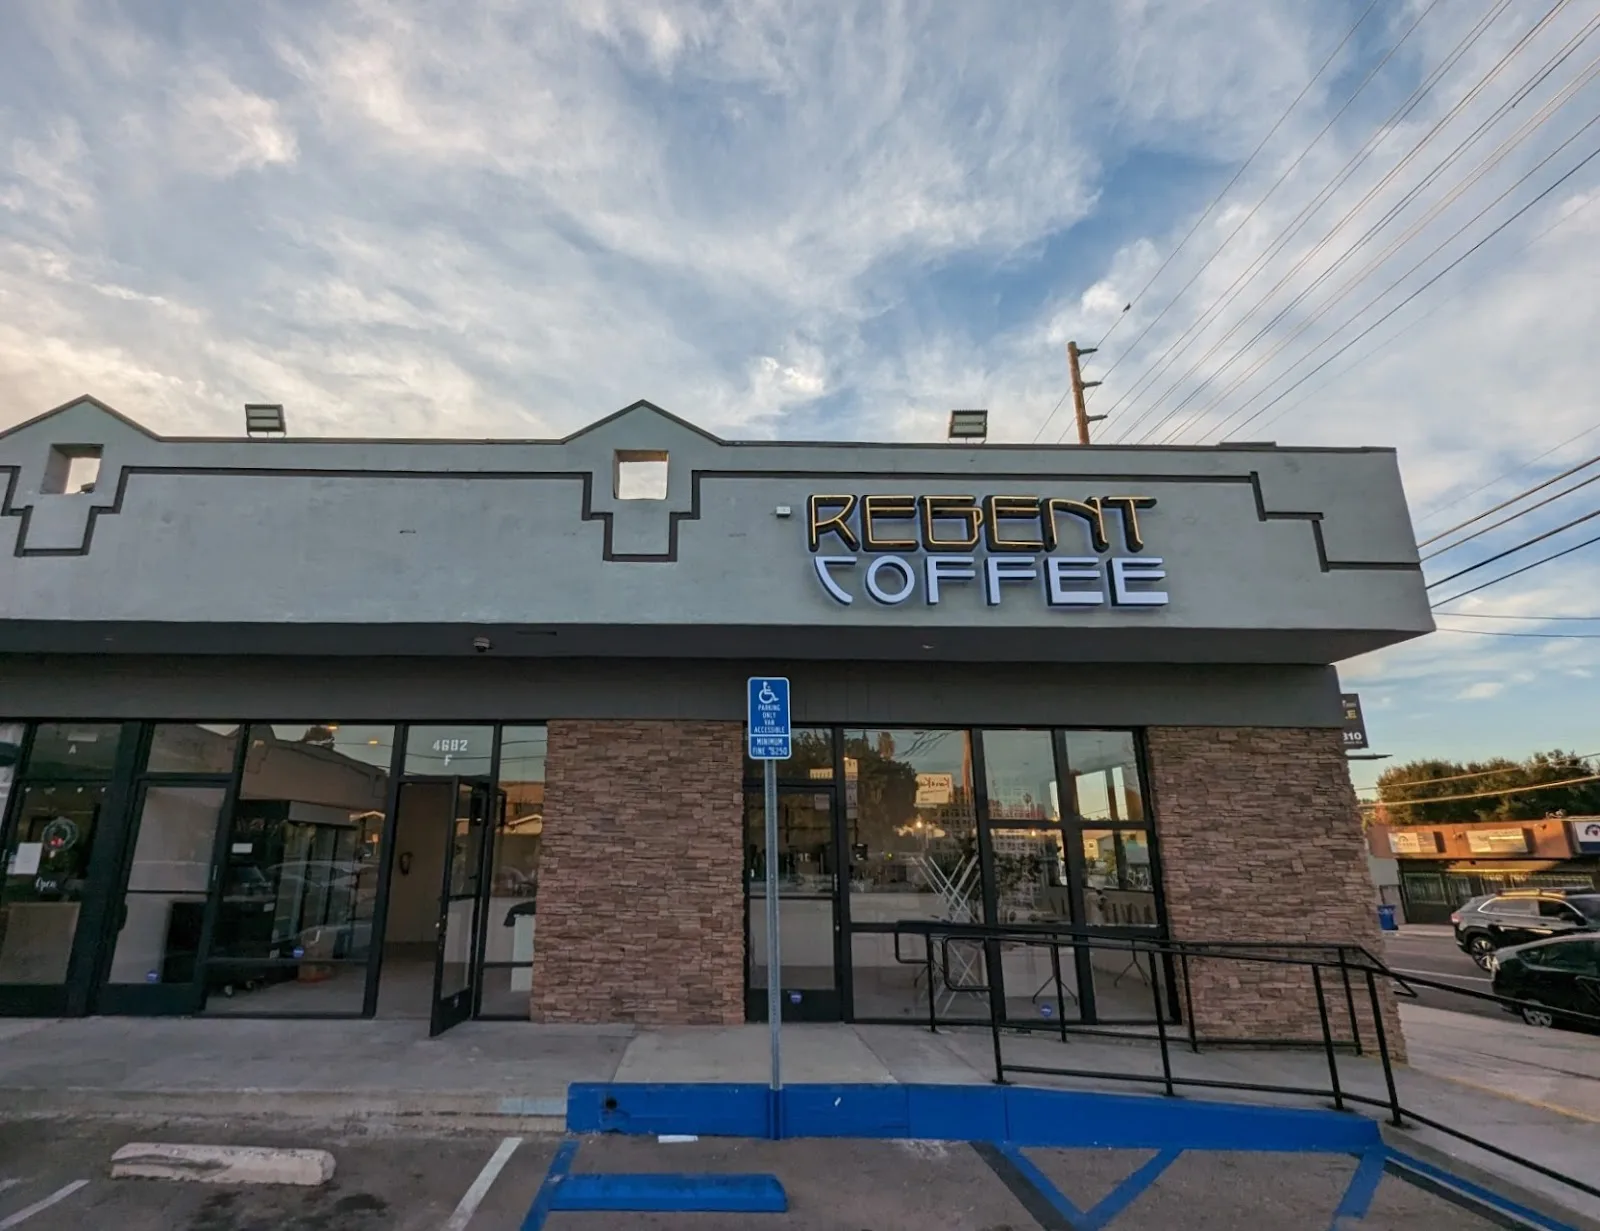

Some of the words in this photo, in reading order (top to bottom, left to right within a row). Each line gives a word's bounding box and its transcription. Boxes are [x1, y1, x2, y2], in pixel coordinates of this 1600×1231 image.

[807, 494, 1157, 552] REGENT
[813, 555, 1169, 606] COFFEE
[756, 737, 783, 746] MINIMUM
[753, 747, 766, 755] FINE
[444, 754, 452, 766] F
[36, 877, 57, 891] Open
